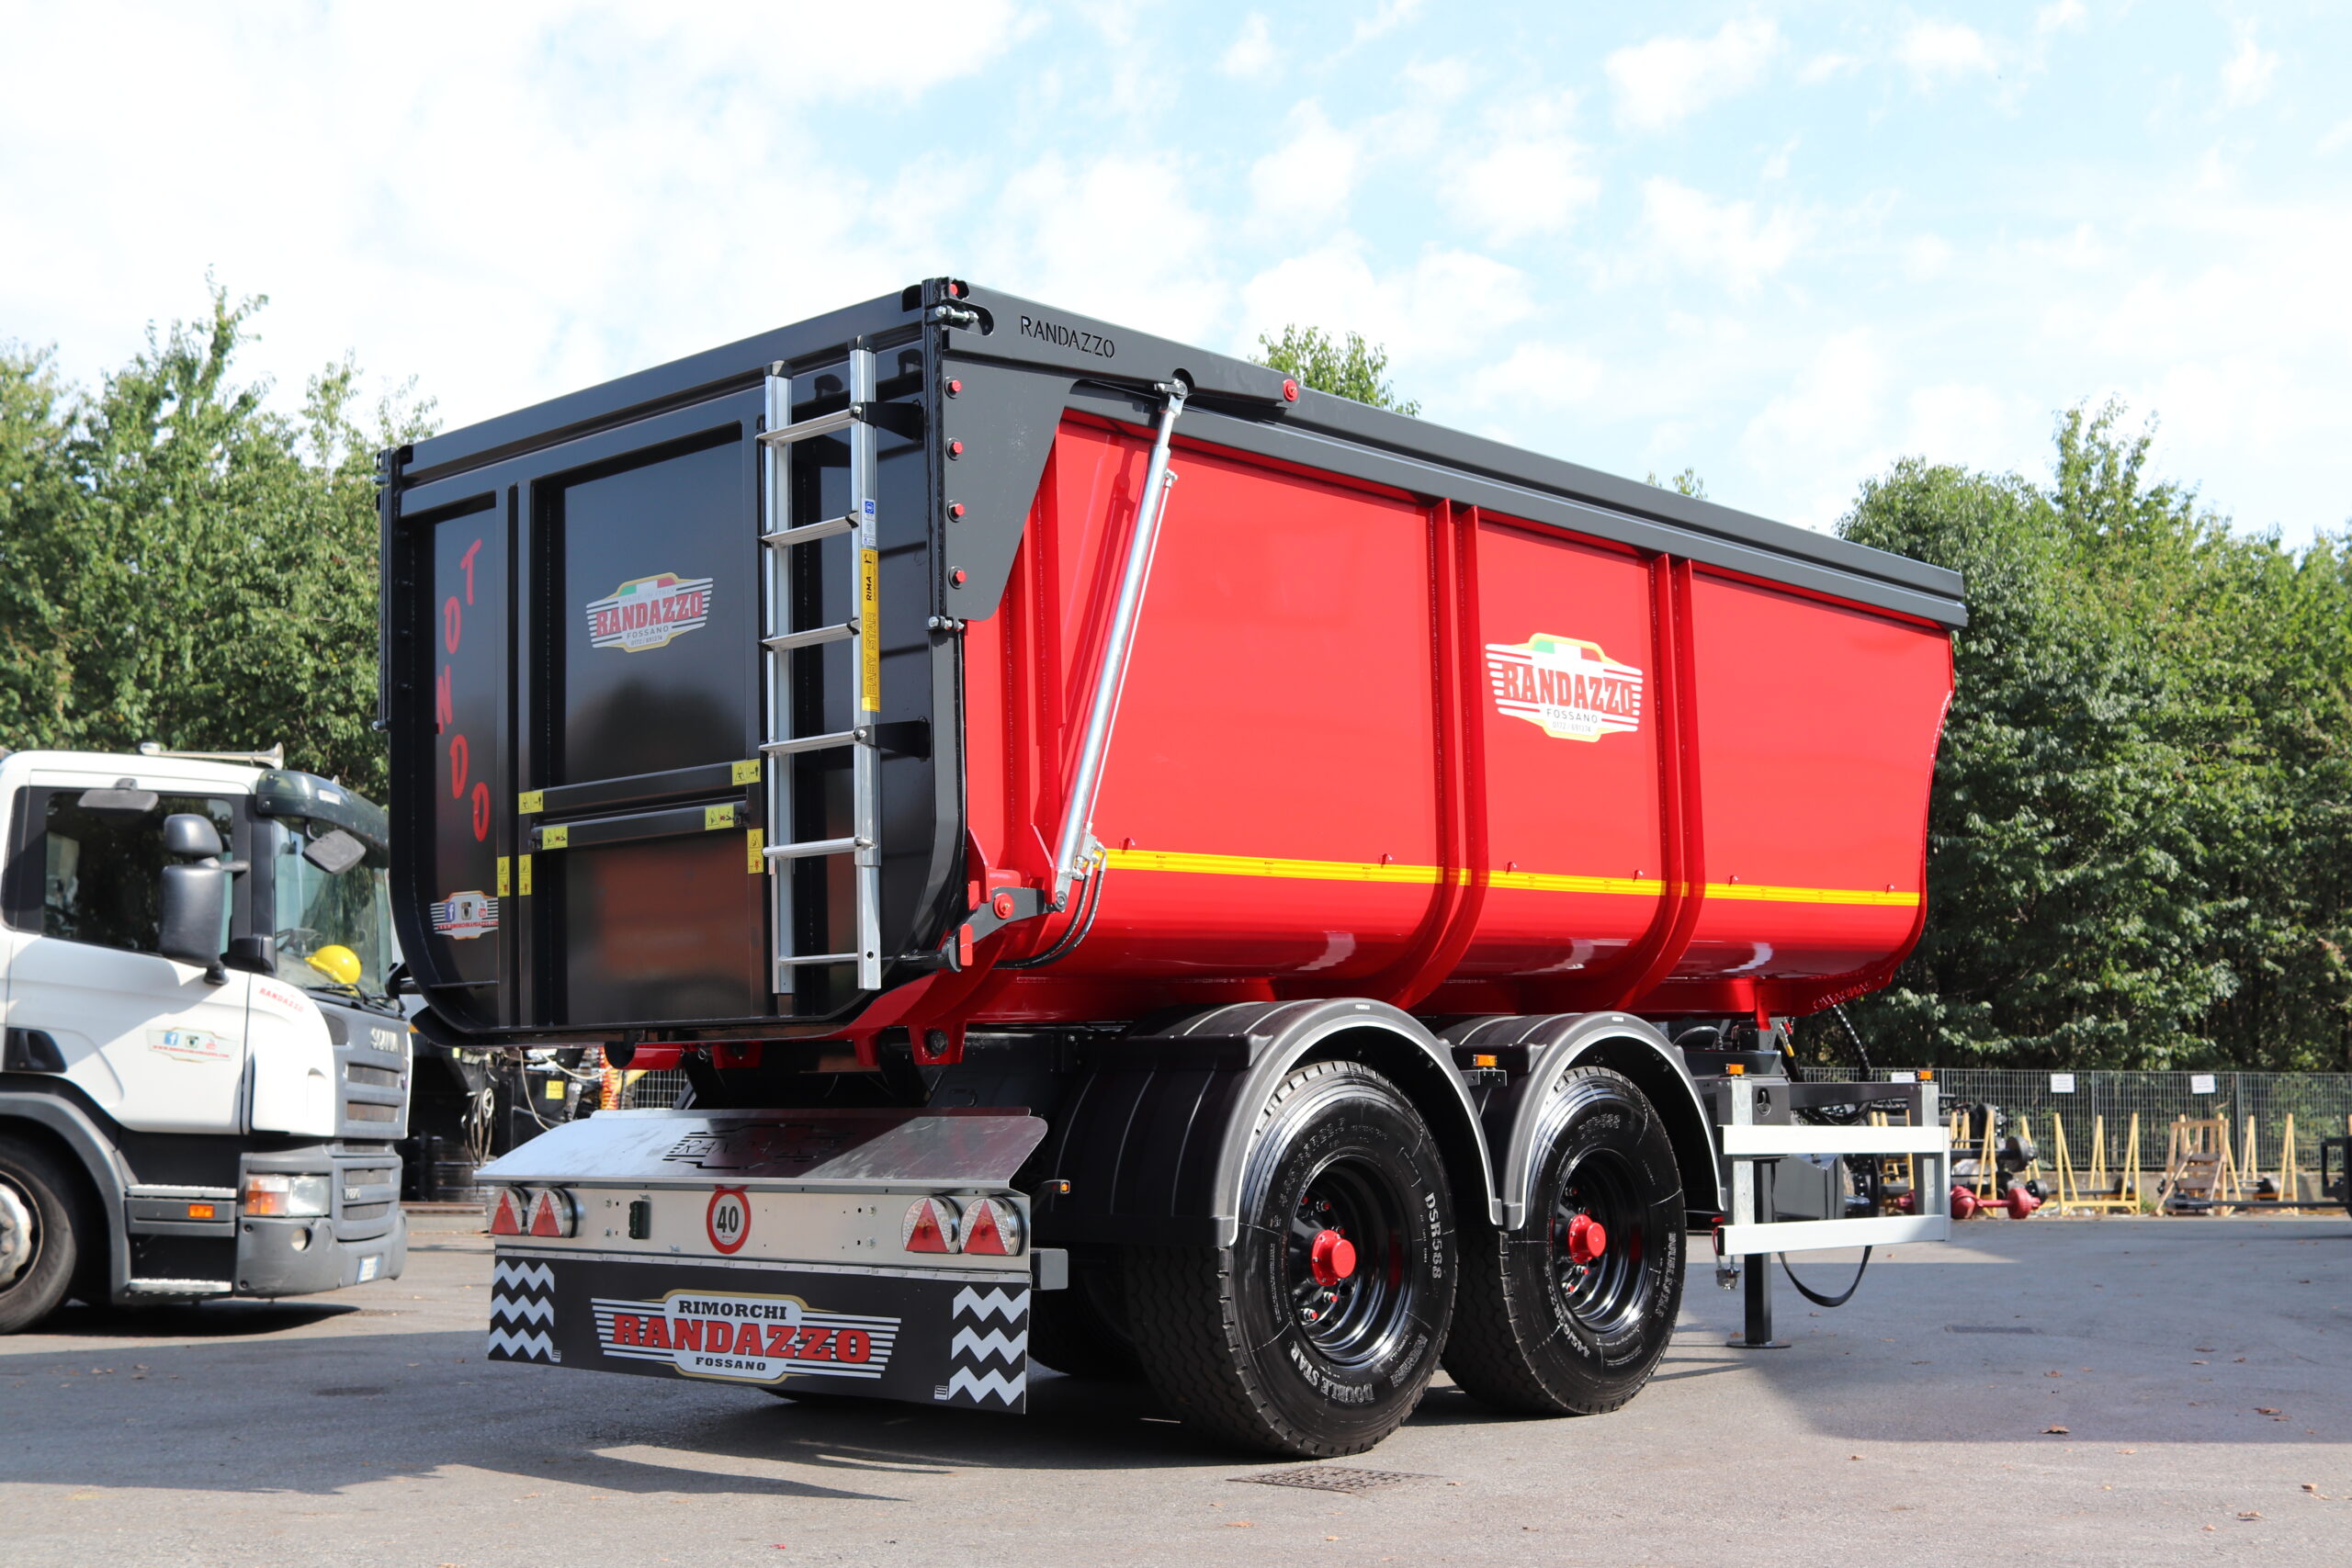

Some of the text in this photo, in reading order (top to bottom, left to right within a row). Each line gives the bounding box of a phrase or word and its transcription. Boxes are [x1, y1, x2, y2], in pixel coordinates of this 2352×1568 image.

[1021, 315, 1115, 358] RANDAZZO
[595, 591, 704, 637] RANDAZZO
[627, 625, 669, 639] FOSSANO
[866, 612, 877, 695] BABY STAR
[1502, 661, 1634, 716] RANDAZZO
[1547, 708, 1598, 723] FOSSANO
[259, 987, 304, 1013] RANDAZZO
[717, 1206, 739, 1233] 40
[1424, 1192, 1442, 1278] DSR588
[678, 1300, 787, 1320] RIMORCHI
[613, 1314, 871, 1364] RANDAZZO
[695, 1357, 766, 1371] FOSSANO
[1319, 1376, 1375, 1404] DOUBLE
